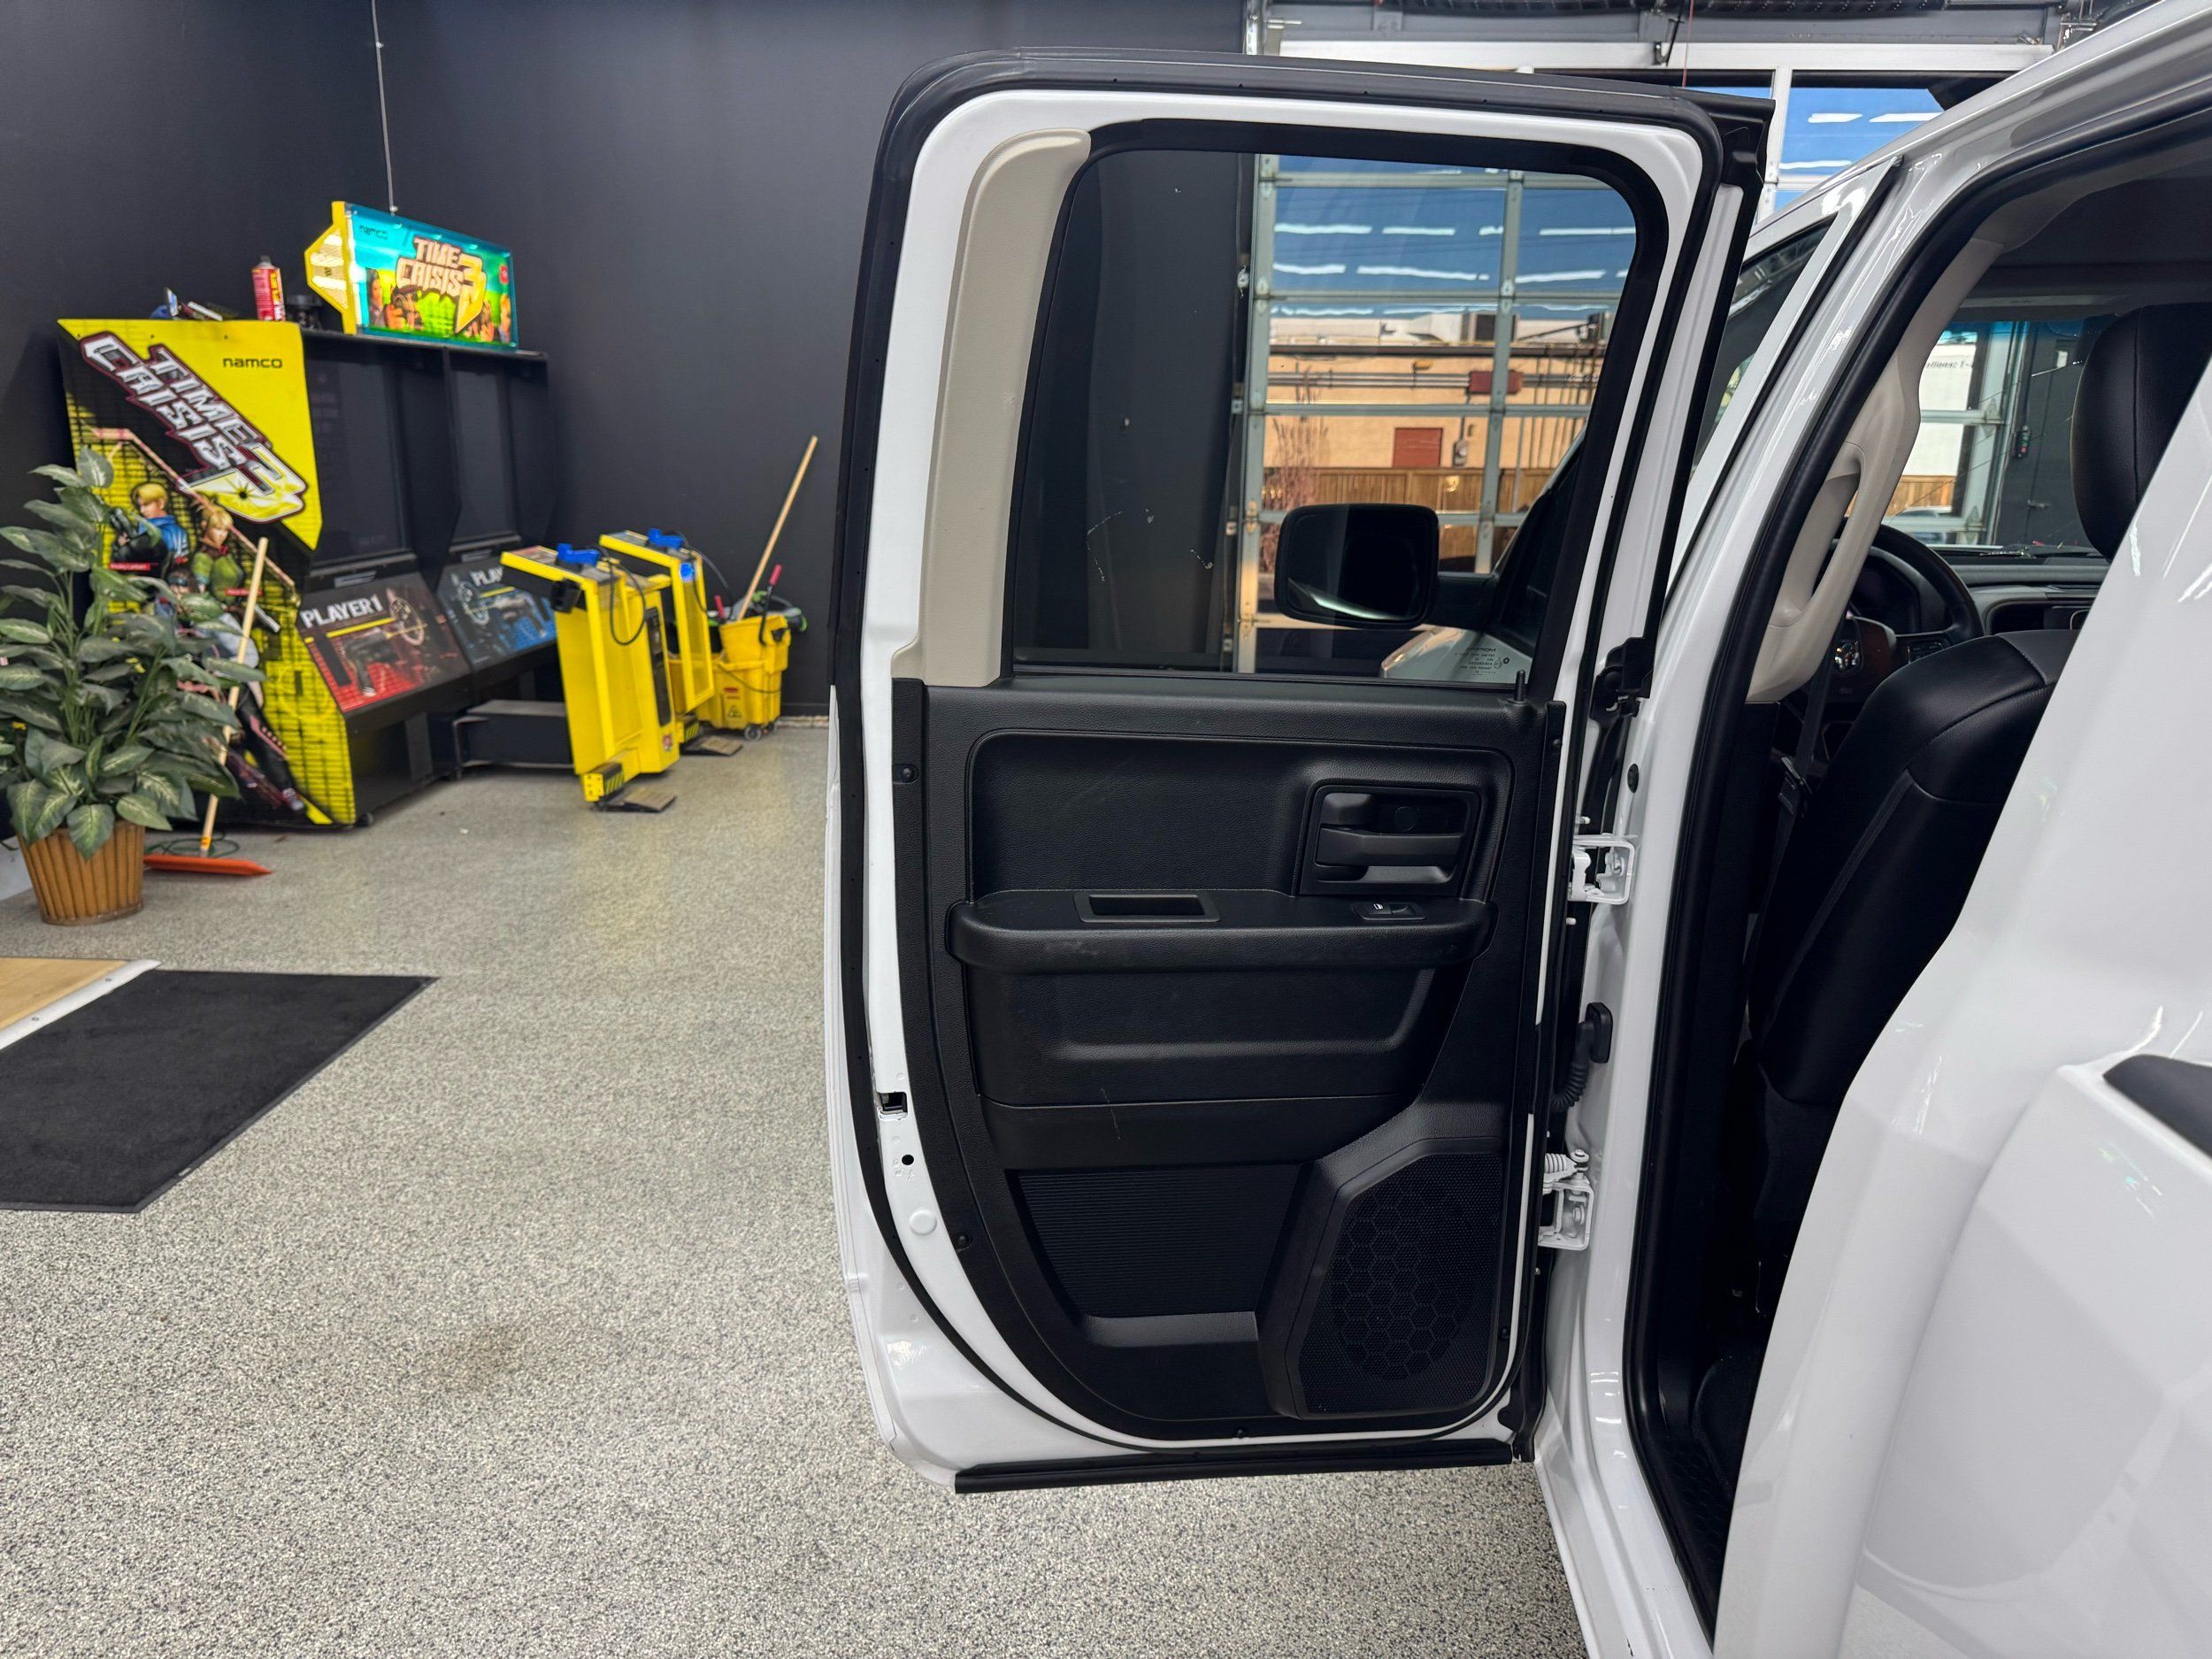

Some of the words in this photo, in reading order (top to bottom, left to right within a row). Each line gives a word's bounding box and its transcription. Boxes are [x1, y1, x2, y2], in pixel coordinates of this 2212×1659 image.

[396, 257, 465, 297] CRISIS
[454, 252, 487, 334] 3
[413, 236, 460, 269] TIME
[83, 335, 248, 471] CRISIS
[150, 348, 261, 446] TIME
[222, 357, 283, 369] namco
